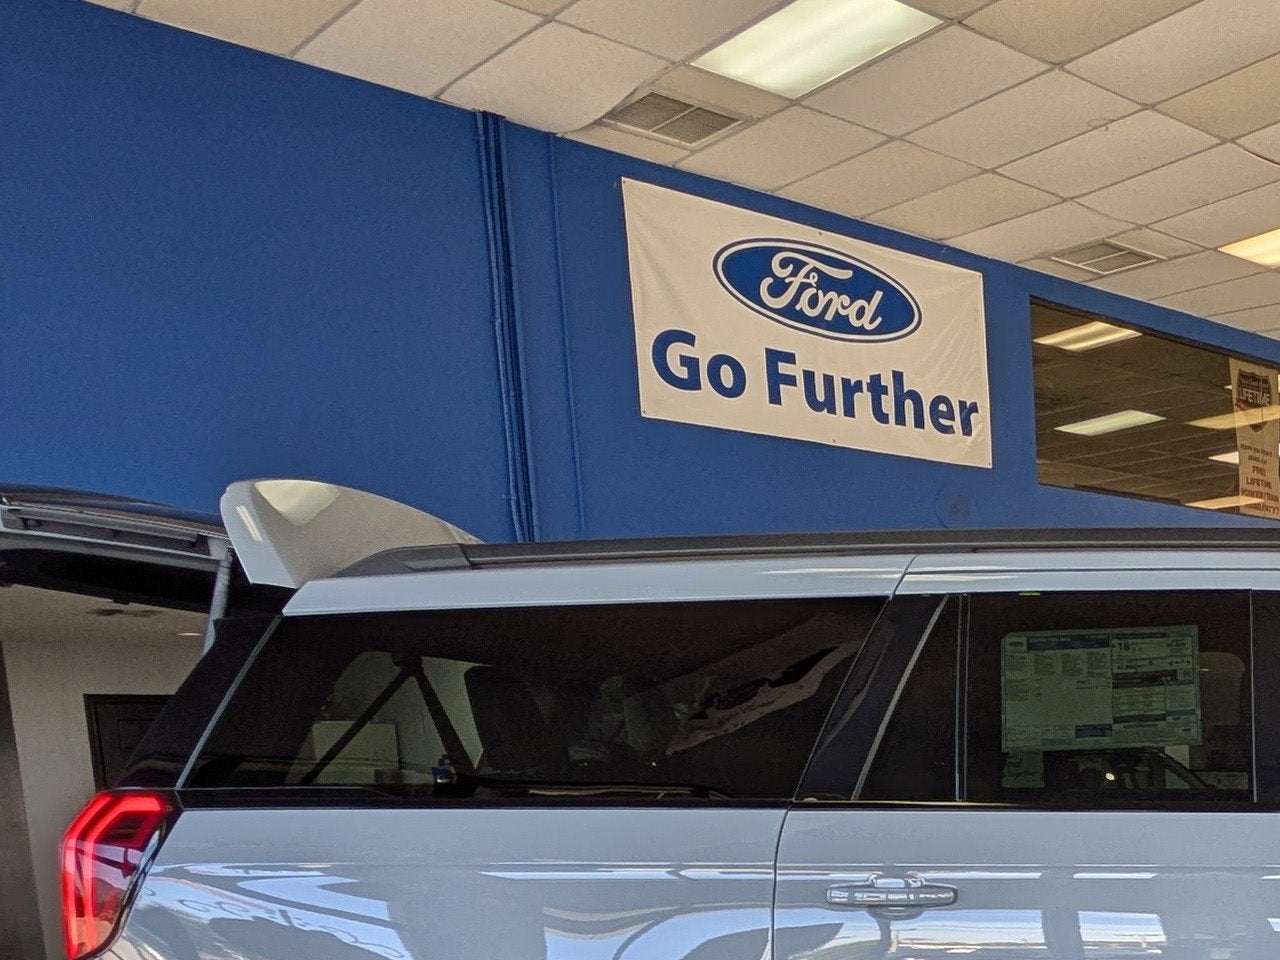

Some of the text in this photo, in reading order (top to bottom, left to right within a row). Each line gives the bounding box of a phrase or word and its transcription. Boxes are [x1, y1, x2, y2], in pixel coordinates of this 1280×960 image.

[759, 250, 884, 331] Ford
[651, 329, 980, 437] Go Further
